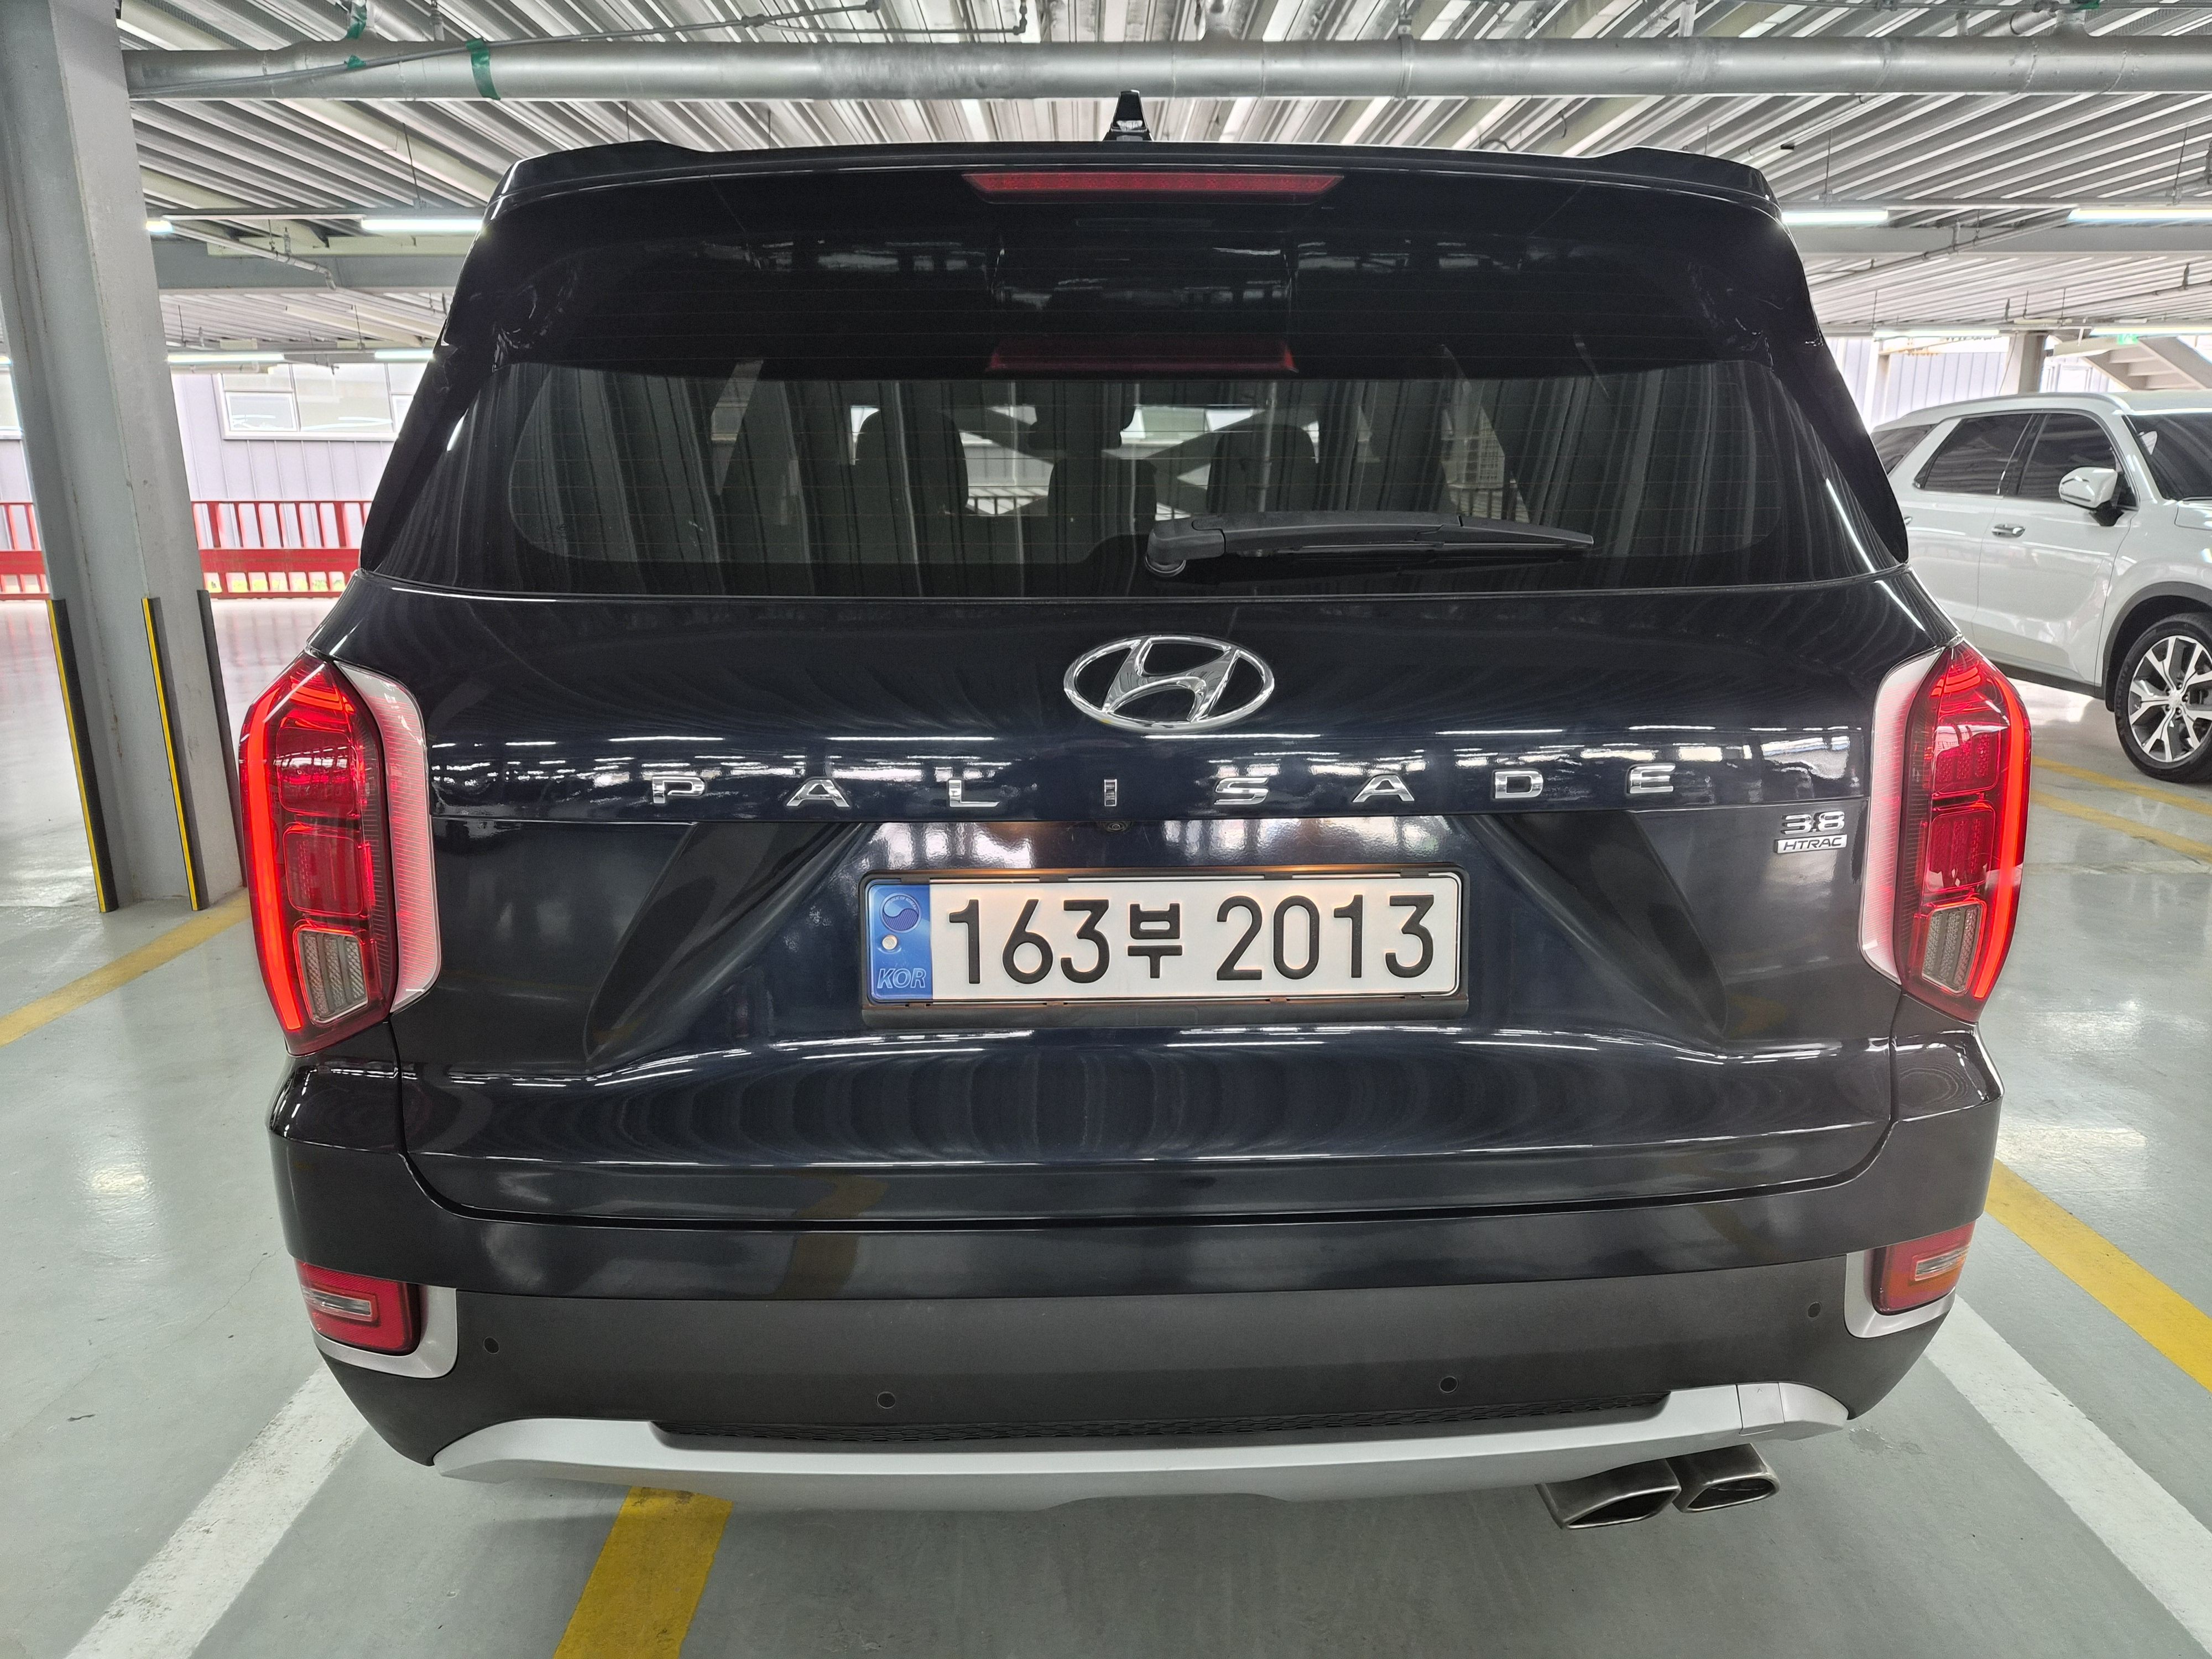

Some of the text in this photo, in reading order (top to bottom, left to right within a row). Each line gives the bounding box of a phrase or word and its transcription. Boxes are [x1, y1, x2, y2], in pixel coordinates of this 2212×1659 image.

[652, 765, 1676, 807] PALISADE
[1782, 811, 1845, 834] 3.8
[1783, 837, 1843, 851] HTRAC
[949, 895, 1434, 984] 163부 2013
[877, 968, 927, 989] KOR
